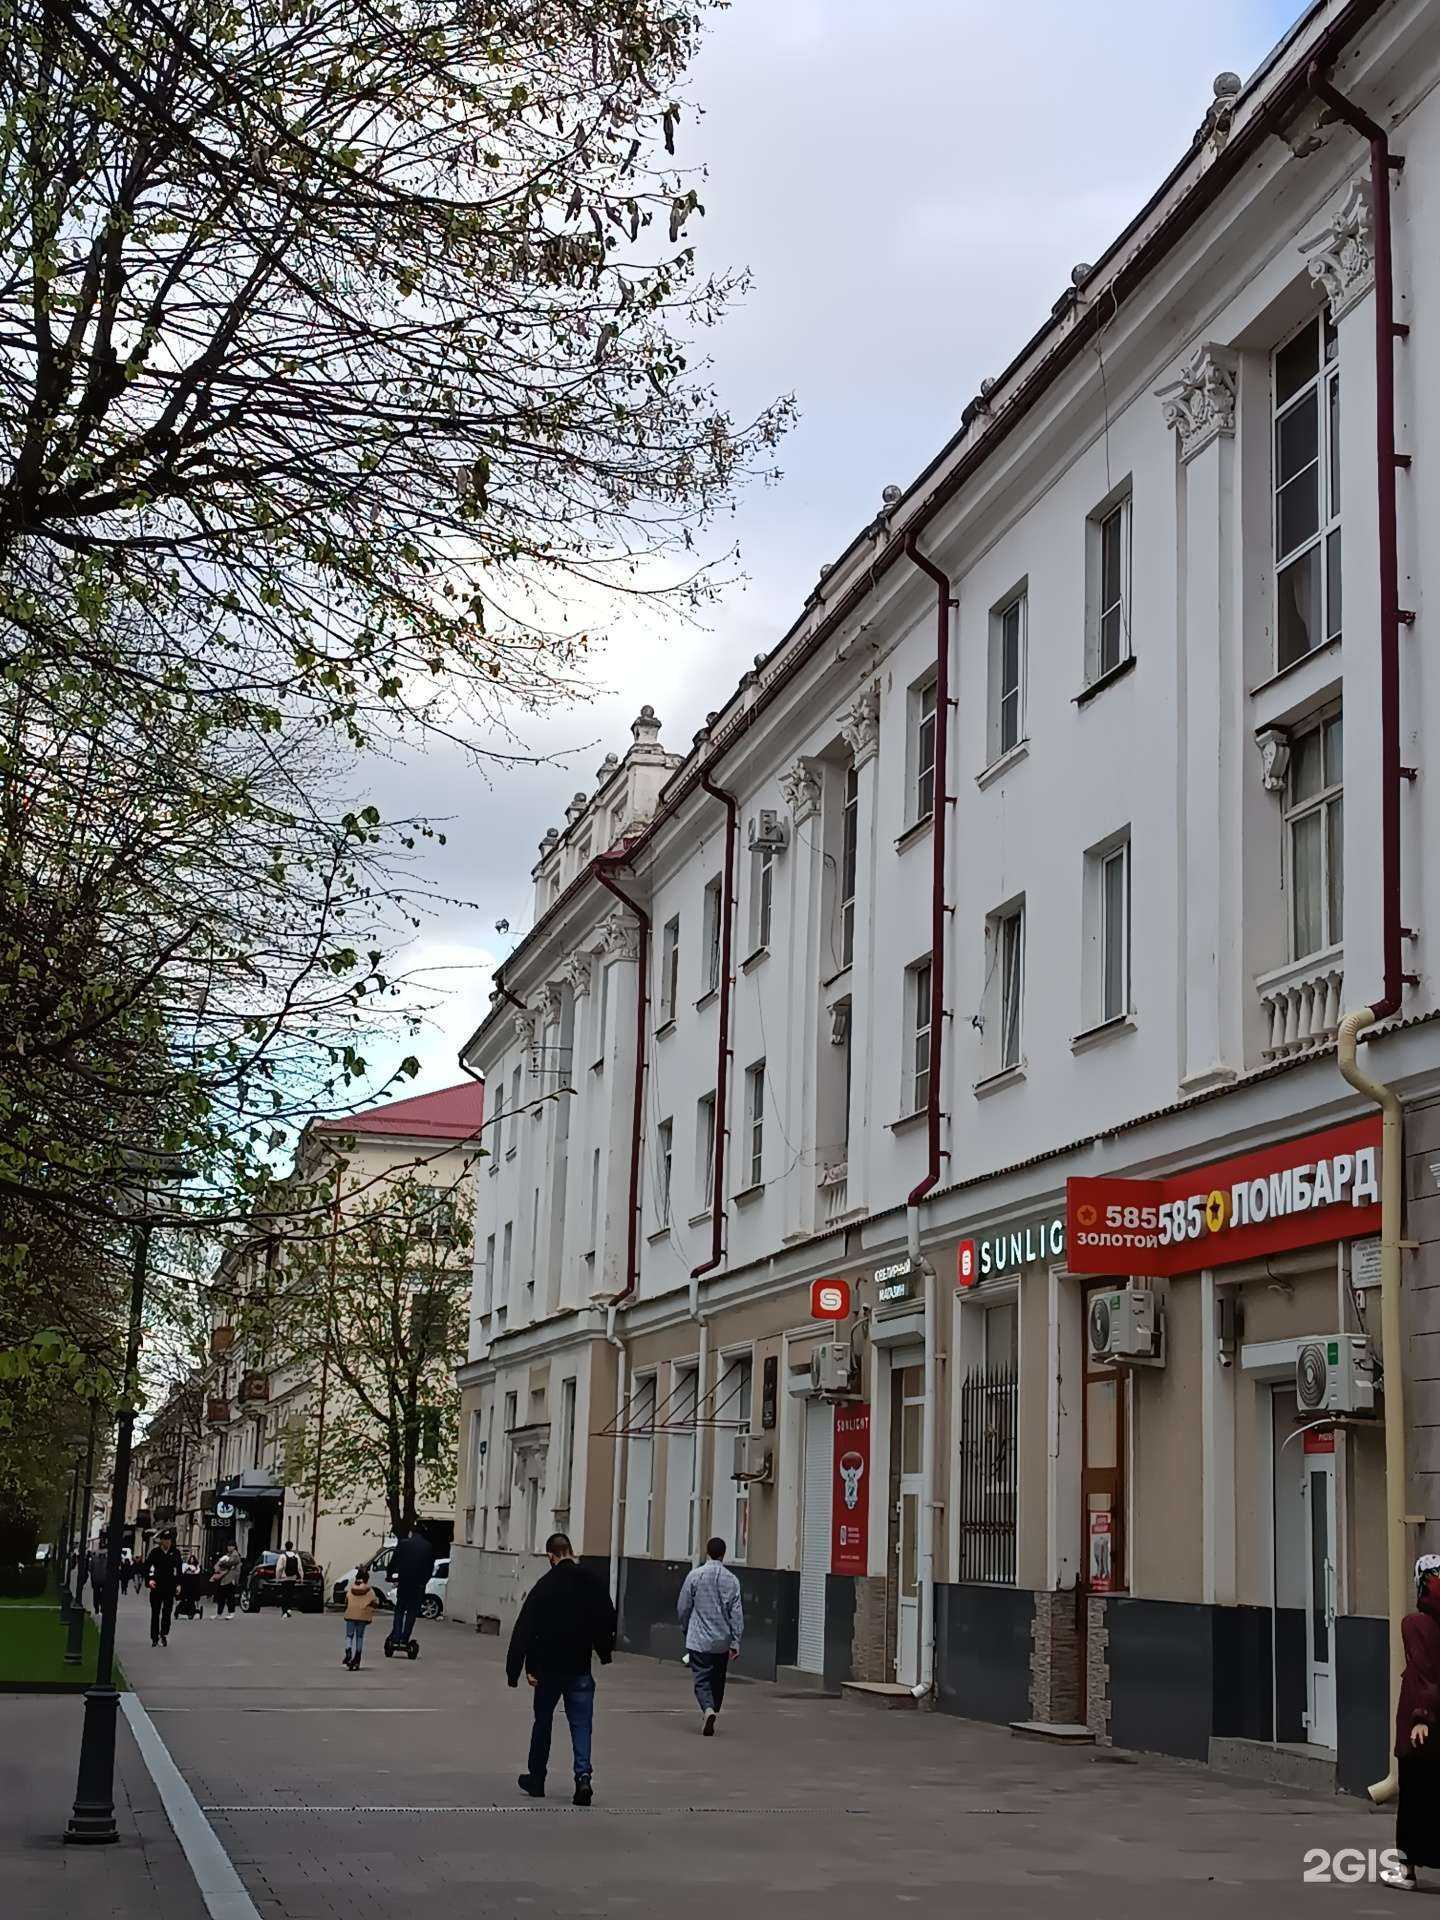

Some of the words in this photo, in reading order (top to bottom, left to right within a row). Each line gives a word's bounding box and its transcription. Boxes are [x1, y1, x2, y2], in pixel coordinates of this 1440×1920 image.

[1158, 1195, 1204, 1246] 585
[1229, 1147, 1378, 1228] ЛОМБАРД
[1105, 1205, 1158, 1229] 585
[981, 1220, 1064, 1274] SUNLIG
[1076, 1232, 1158, 1249] ЗОЛОТОЙ
